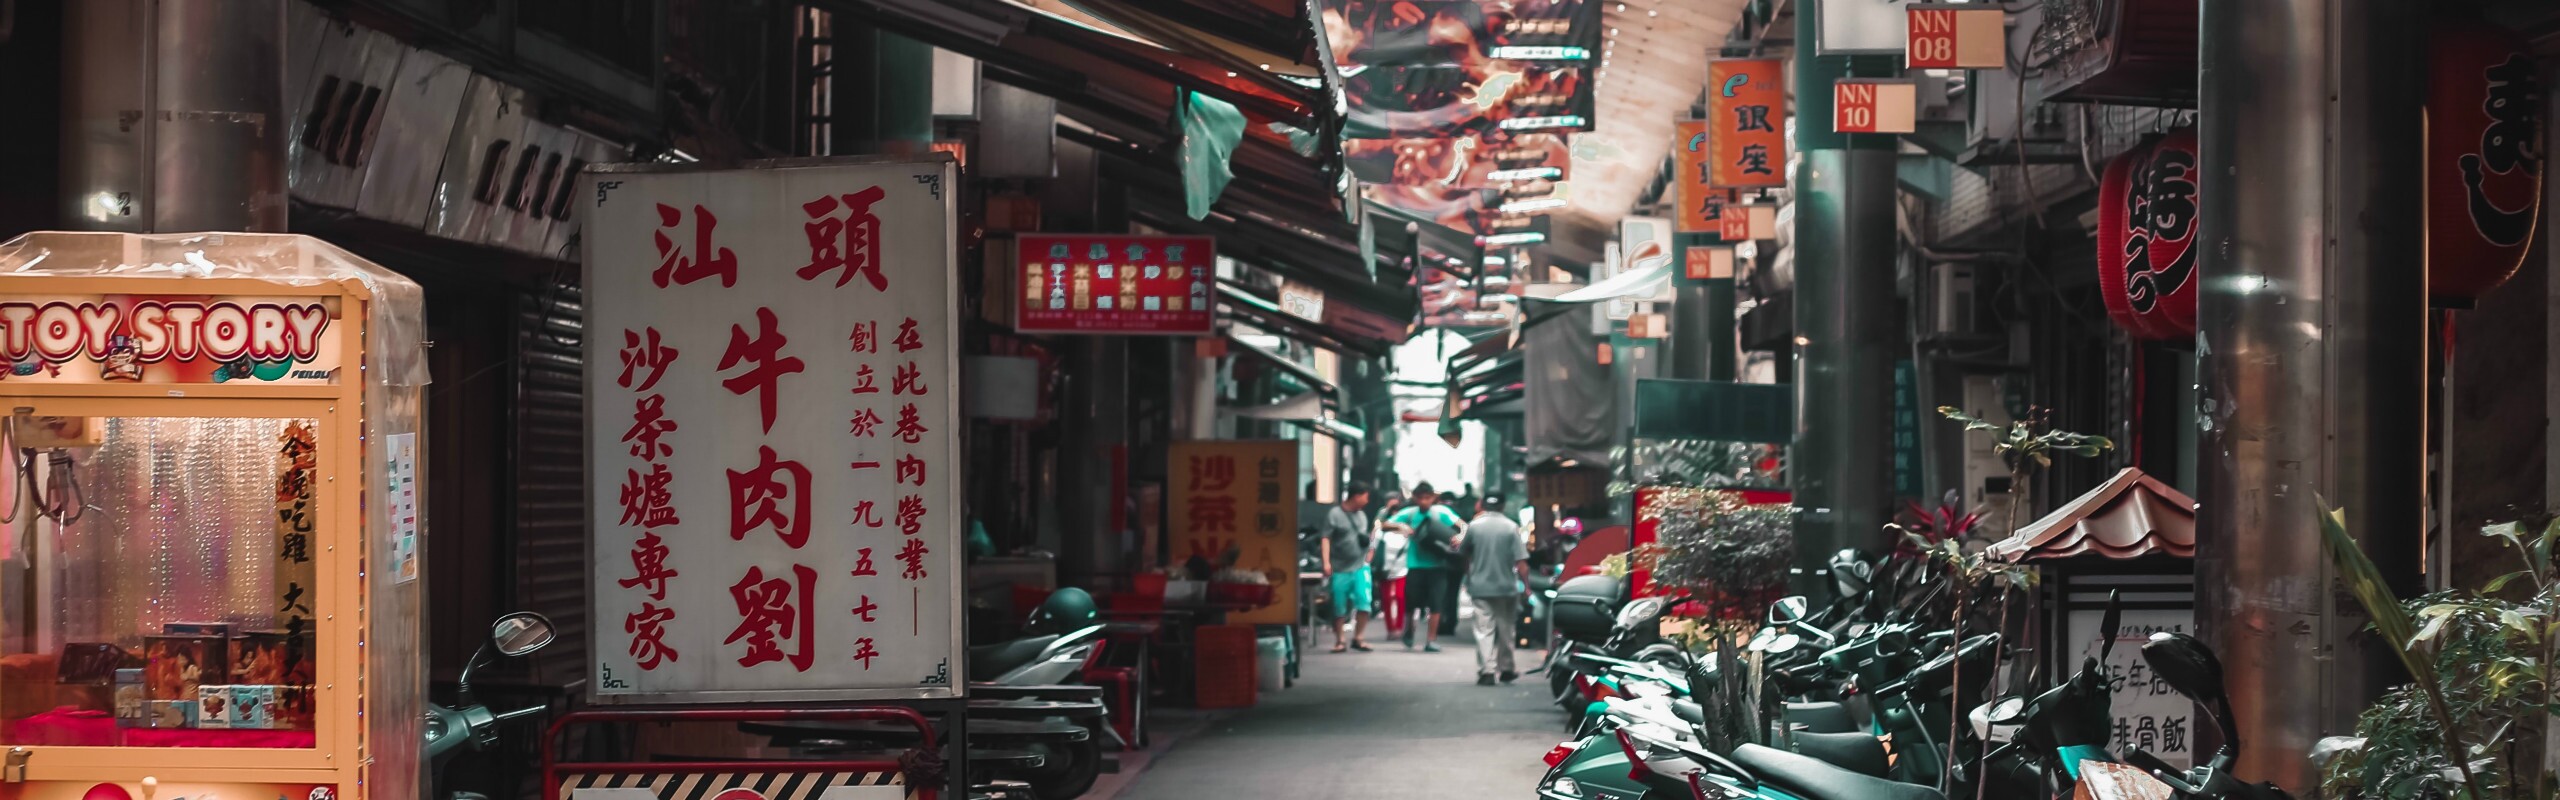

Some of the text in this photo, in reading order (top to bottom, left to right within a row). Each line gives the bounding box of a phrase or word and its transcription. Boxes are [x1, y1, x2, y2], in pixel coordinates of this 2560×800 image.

[1914, 10, 1950, 33] NN
[1914, 37, 1951, 61] 08
[1841, 84, 1873, 104] NN
[1843, 106, 1871, 127] 10
[1734, 104, 1774, 176] 銀座
[1725, 207, 1746, 220] NN
[1727, 223, 1745, 237] 14
[0, 301, 330, 362] TOY STORY
[617, 326, 680, 671] 沙茶爐專家
[716, 306, 819, 673] 牛肉劉
[848, 320, 884, 671] 創立於一九五七年
